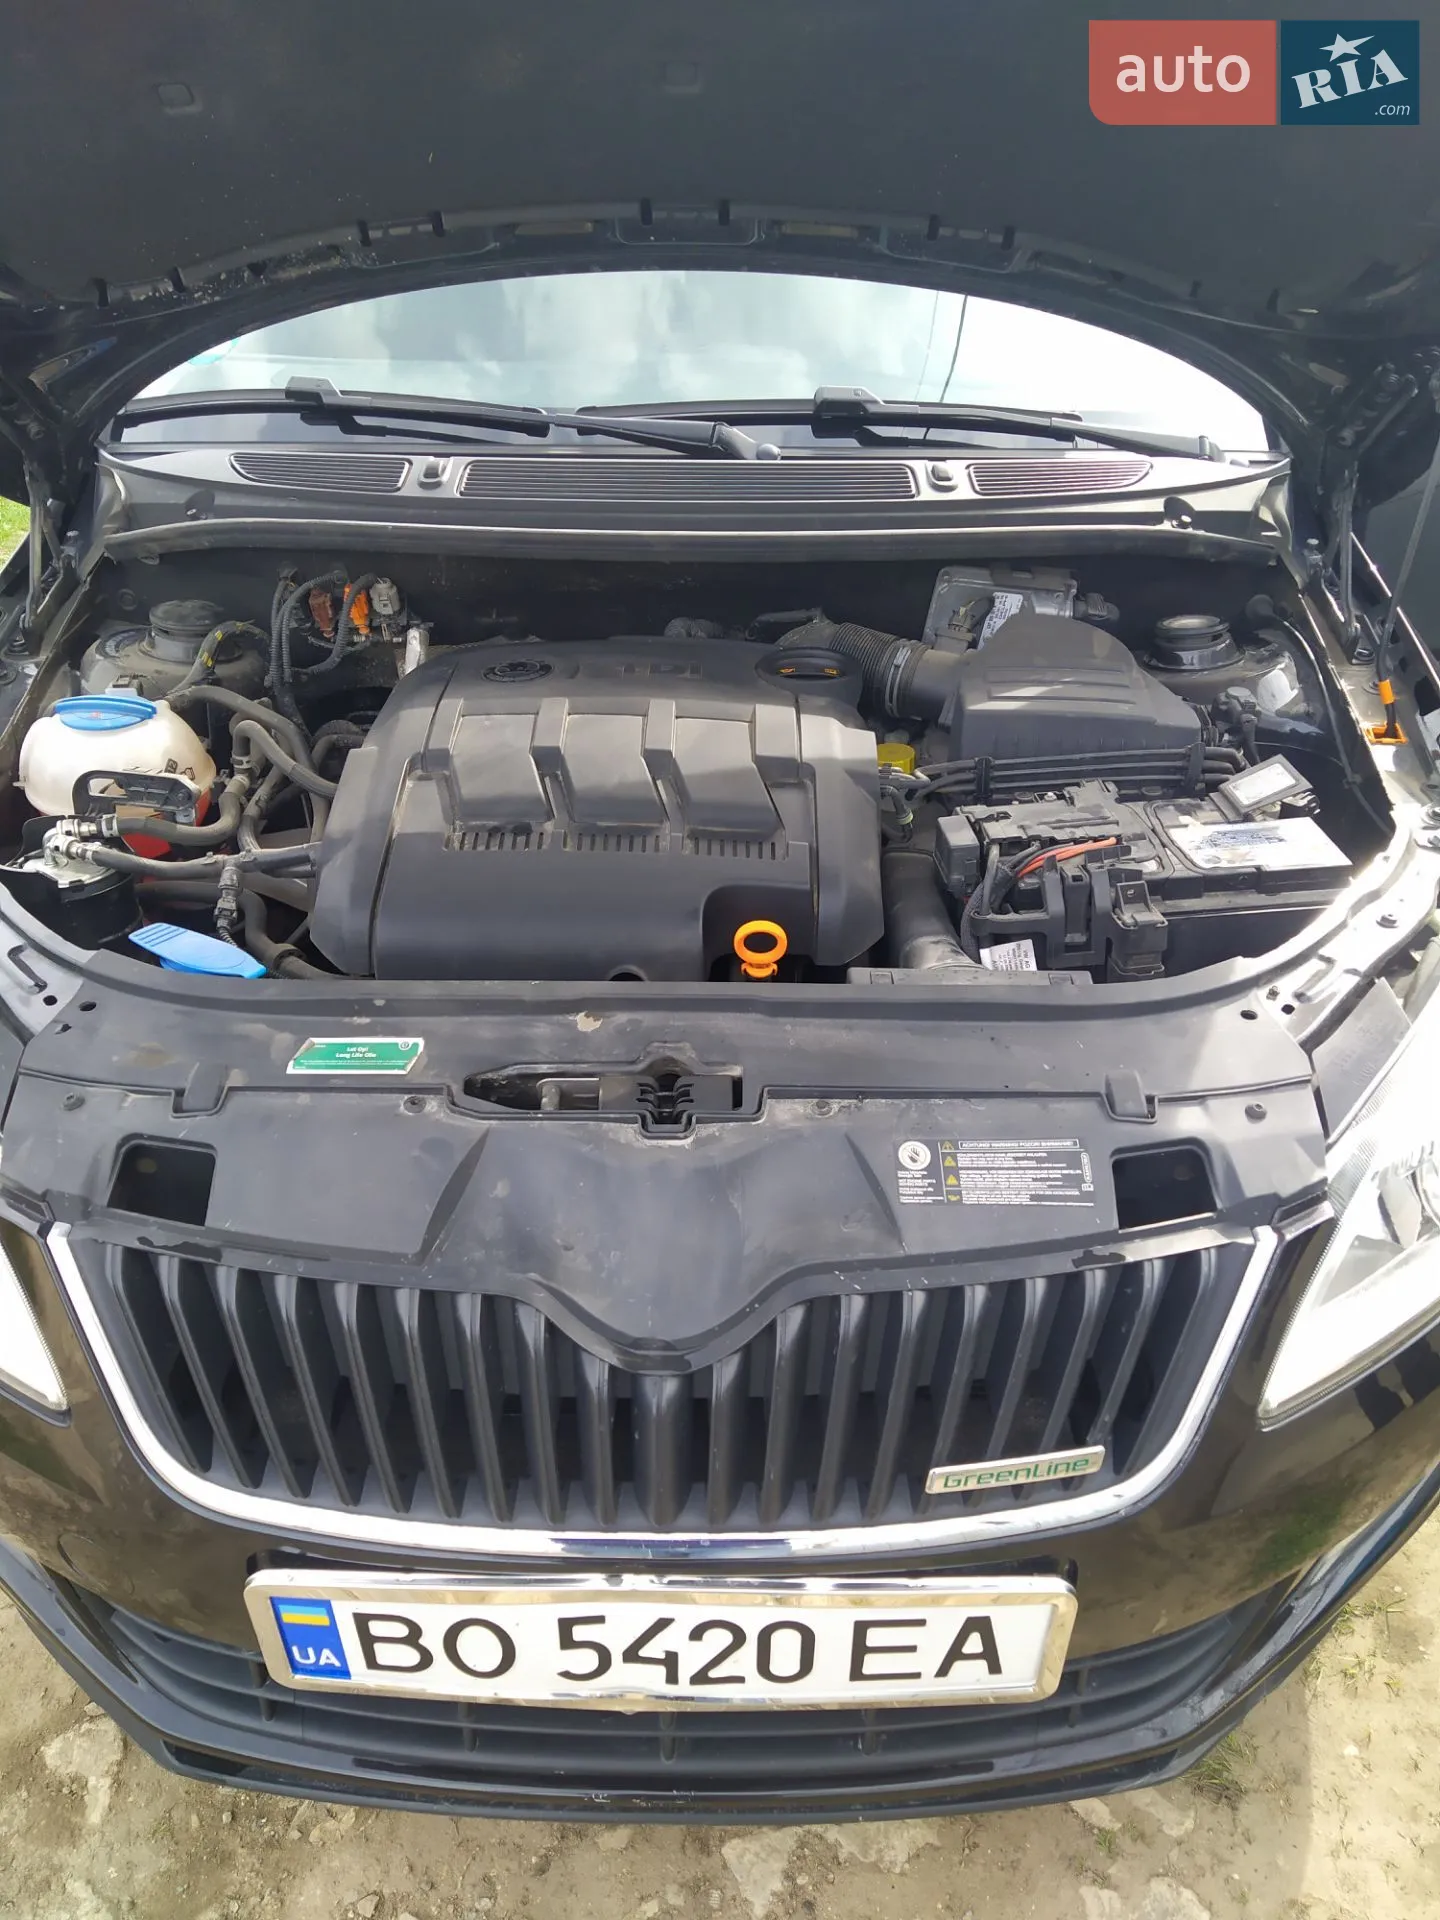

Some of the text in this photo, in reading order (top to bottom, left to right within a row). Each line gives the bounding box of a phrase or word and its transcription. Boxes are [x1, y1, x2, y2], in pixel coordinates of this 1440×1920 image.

[943, 1458, 1089, 1489] GreenLine
[291, 1645, 341, 1667] UA
[352, 1612, 1003, 1686] BO 5420 EA
